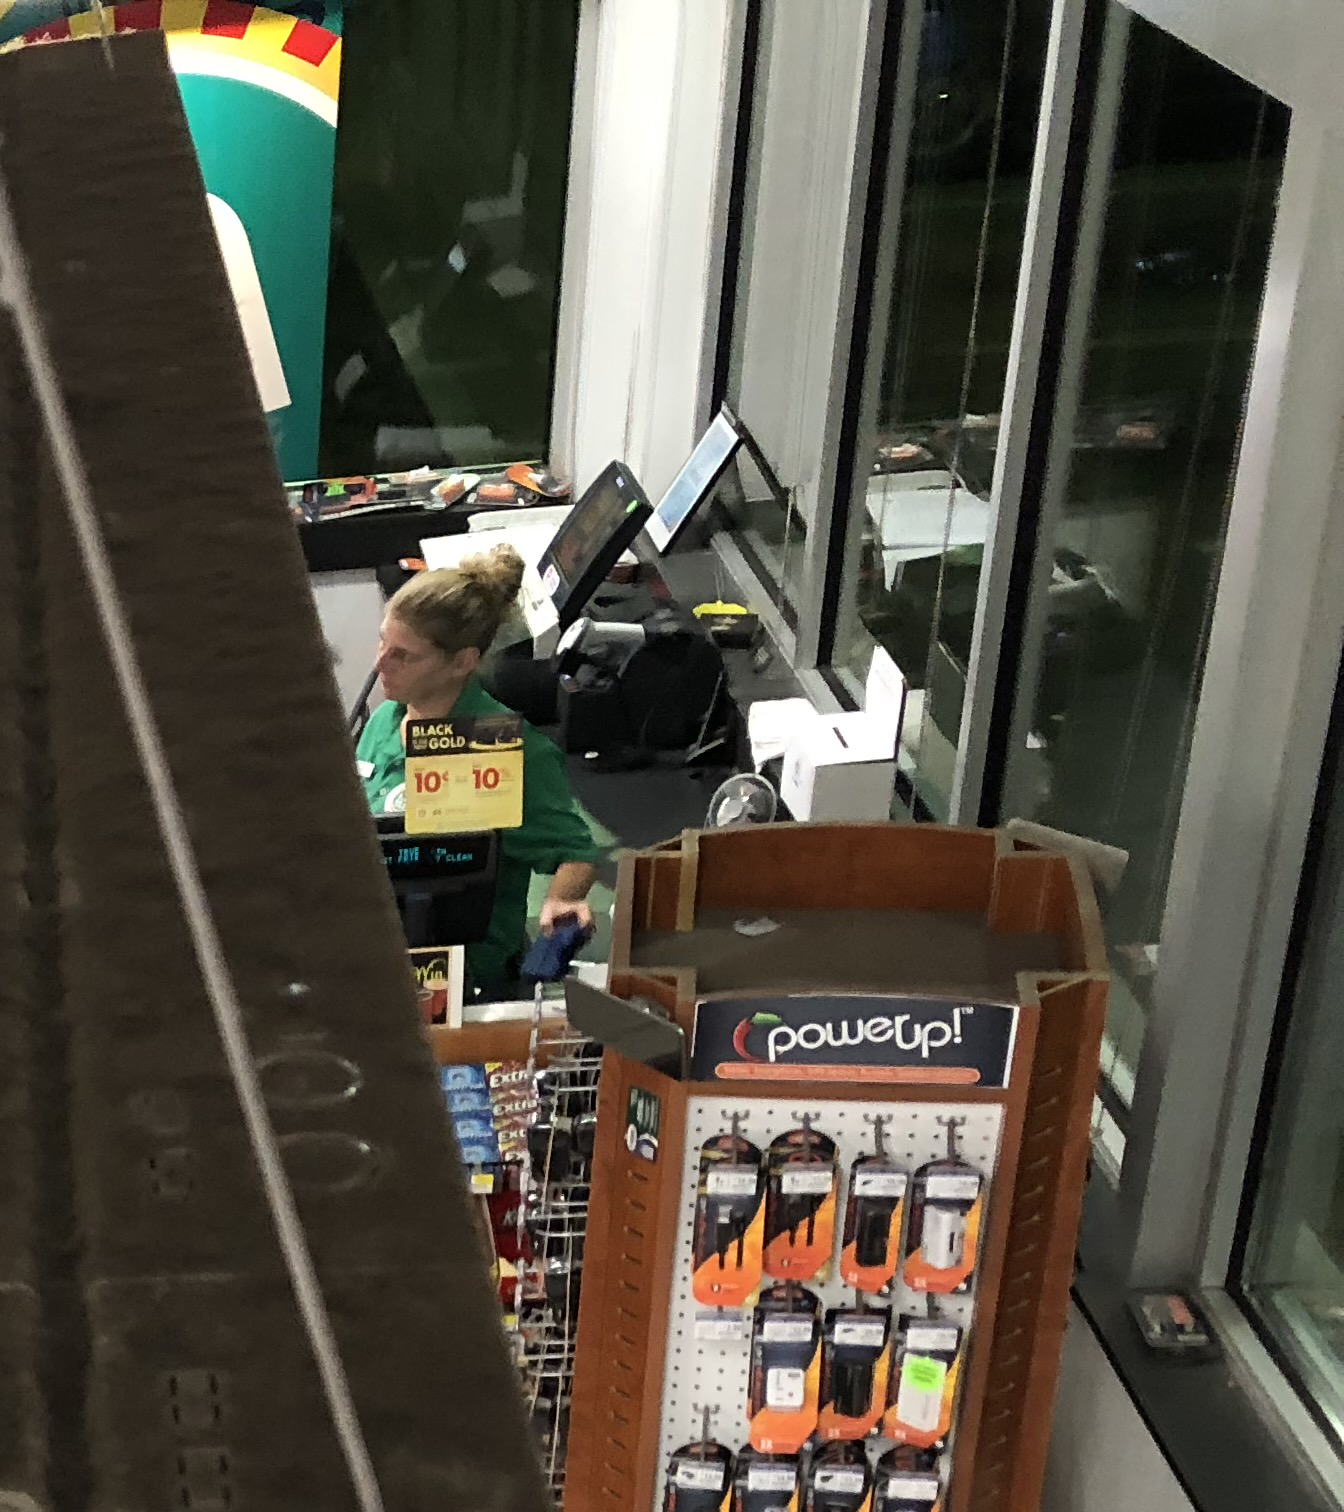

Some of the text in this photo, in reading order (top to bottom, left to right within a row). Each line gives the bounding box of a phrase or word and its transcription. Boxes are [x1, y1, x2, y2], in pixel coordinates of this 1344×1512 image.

[412, 723, 453, 738] BLACK
[429, 736, 466, 750] GOLD
[498, 1129, 528, 1143] Ext
